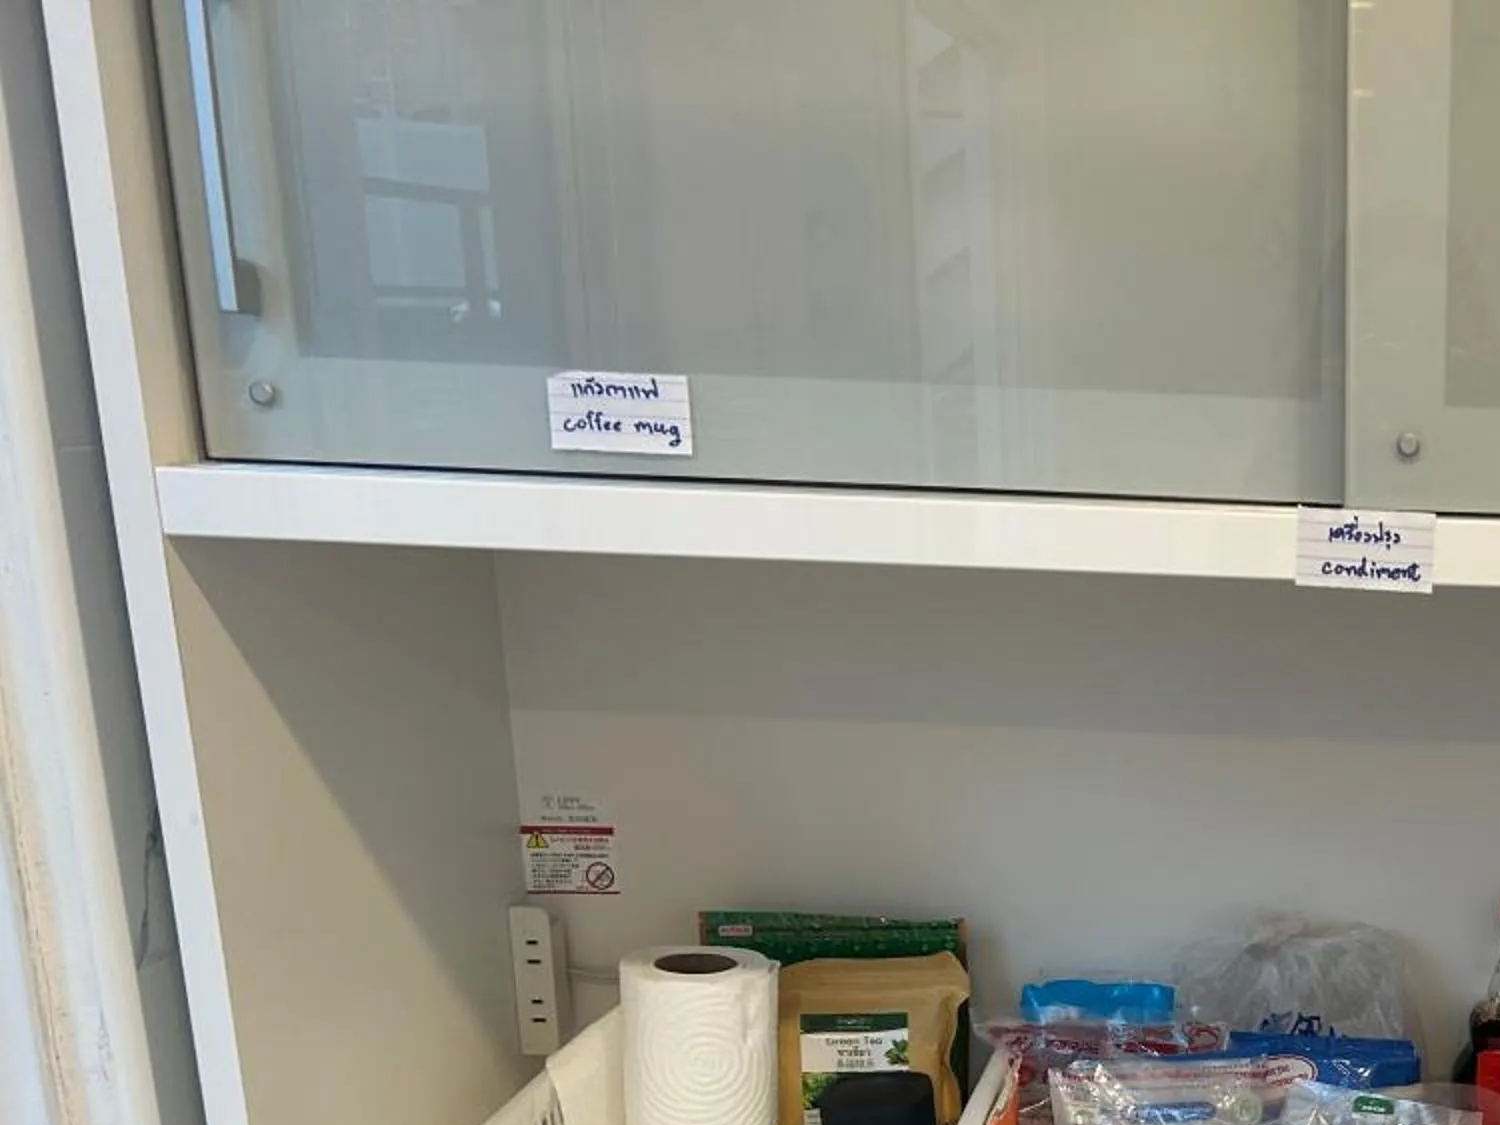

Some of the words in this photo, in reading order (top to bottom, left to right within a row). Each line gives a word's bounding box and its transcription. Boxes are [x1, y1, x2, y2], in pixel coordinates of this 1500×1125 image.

[563, 411, 622, 432] coffee
[634, 419, 682, 447] mug
[1321, 556, 1421, 582] condiment
